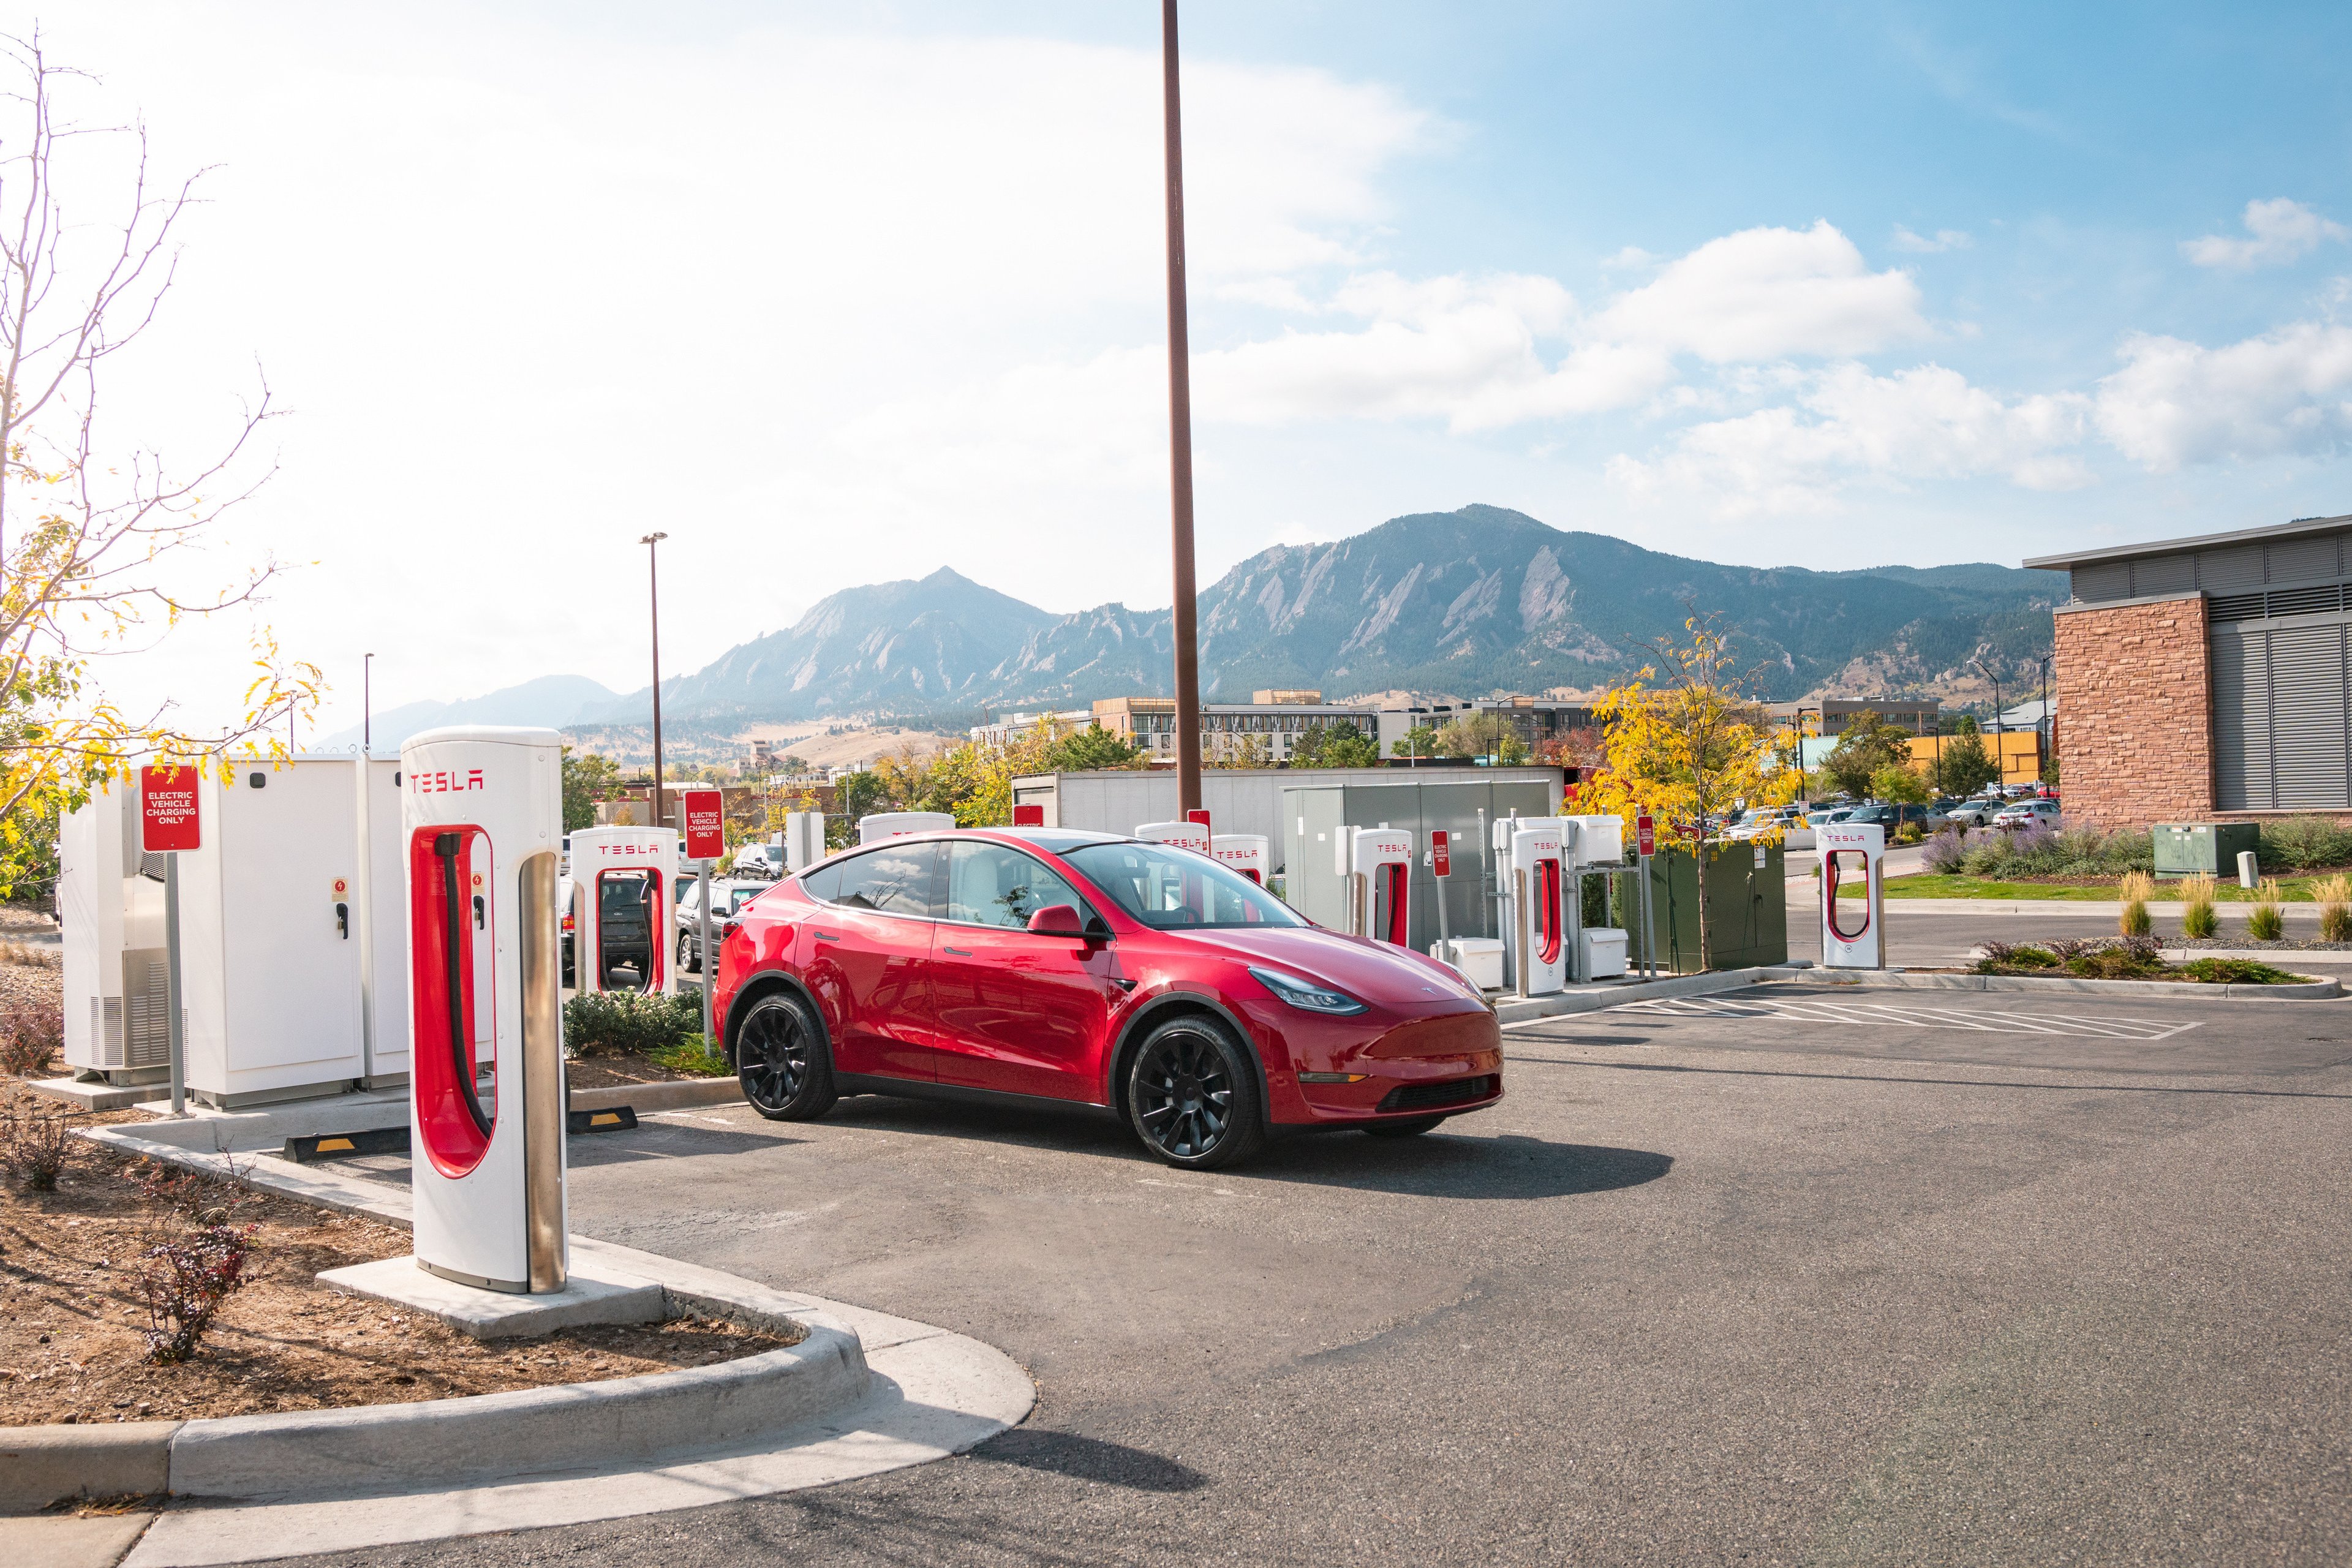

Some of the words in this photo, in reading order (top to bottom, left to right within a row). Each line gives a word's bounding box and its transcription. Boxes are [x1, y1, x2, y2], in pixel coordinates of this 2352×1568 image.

[410, 769, 483, 794] TESLA
[598, 845, 658, 854] TESLA
[1216, 850, 1257, 859] TESLA
